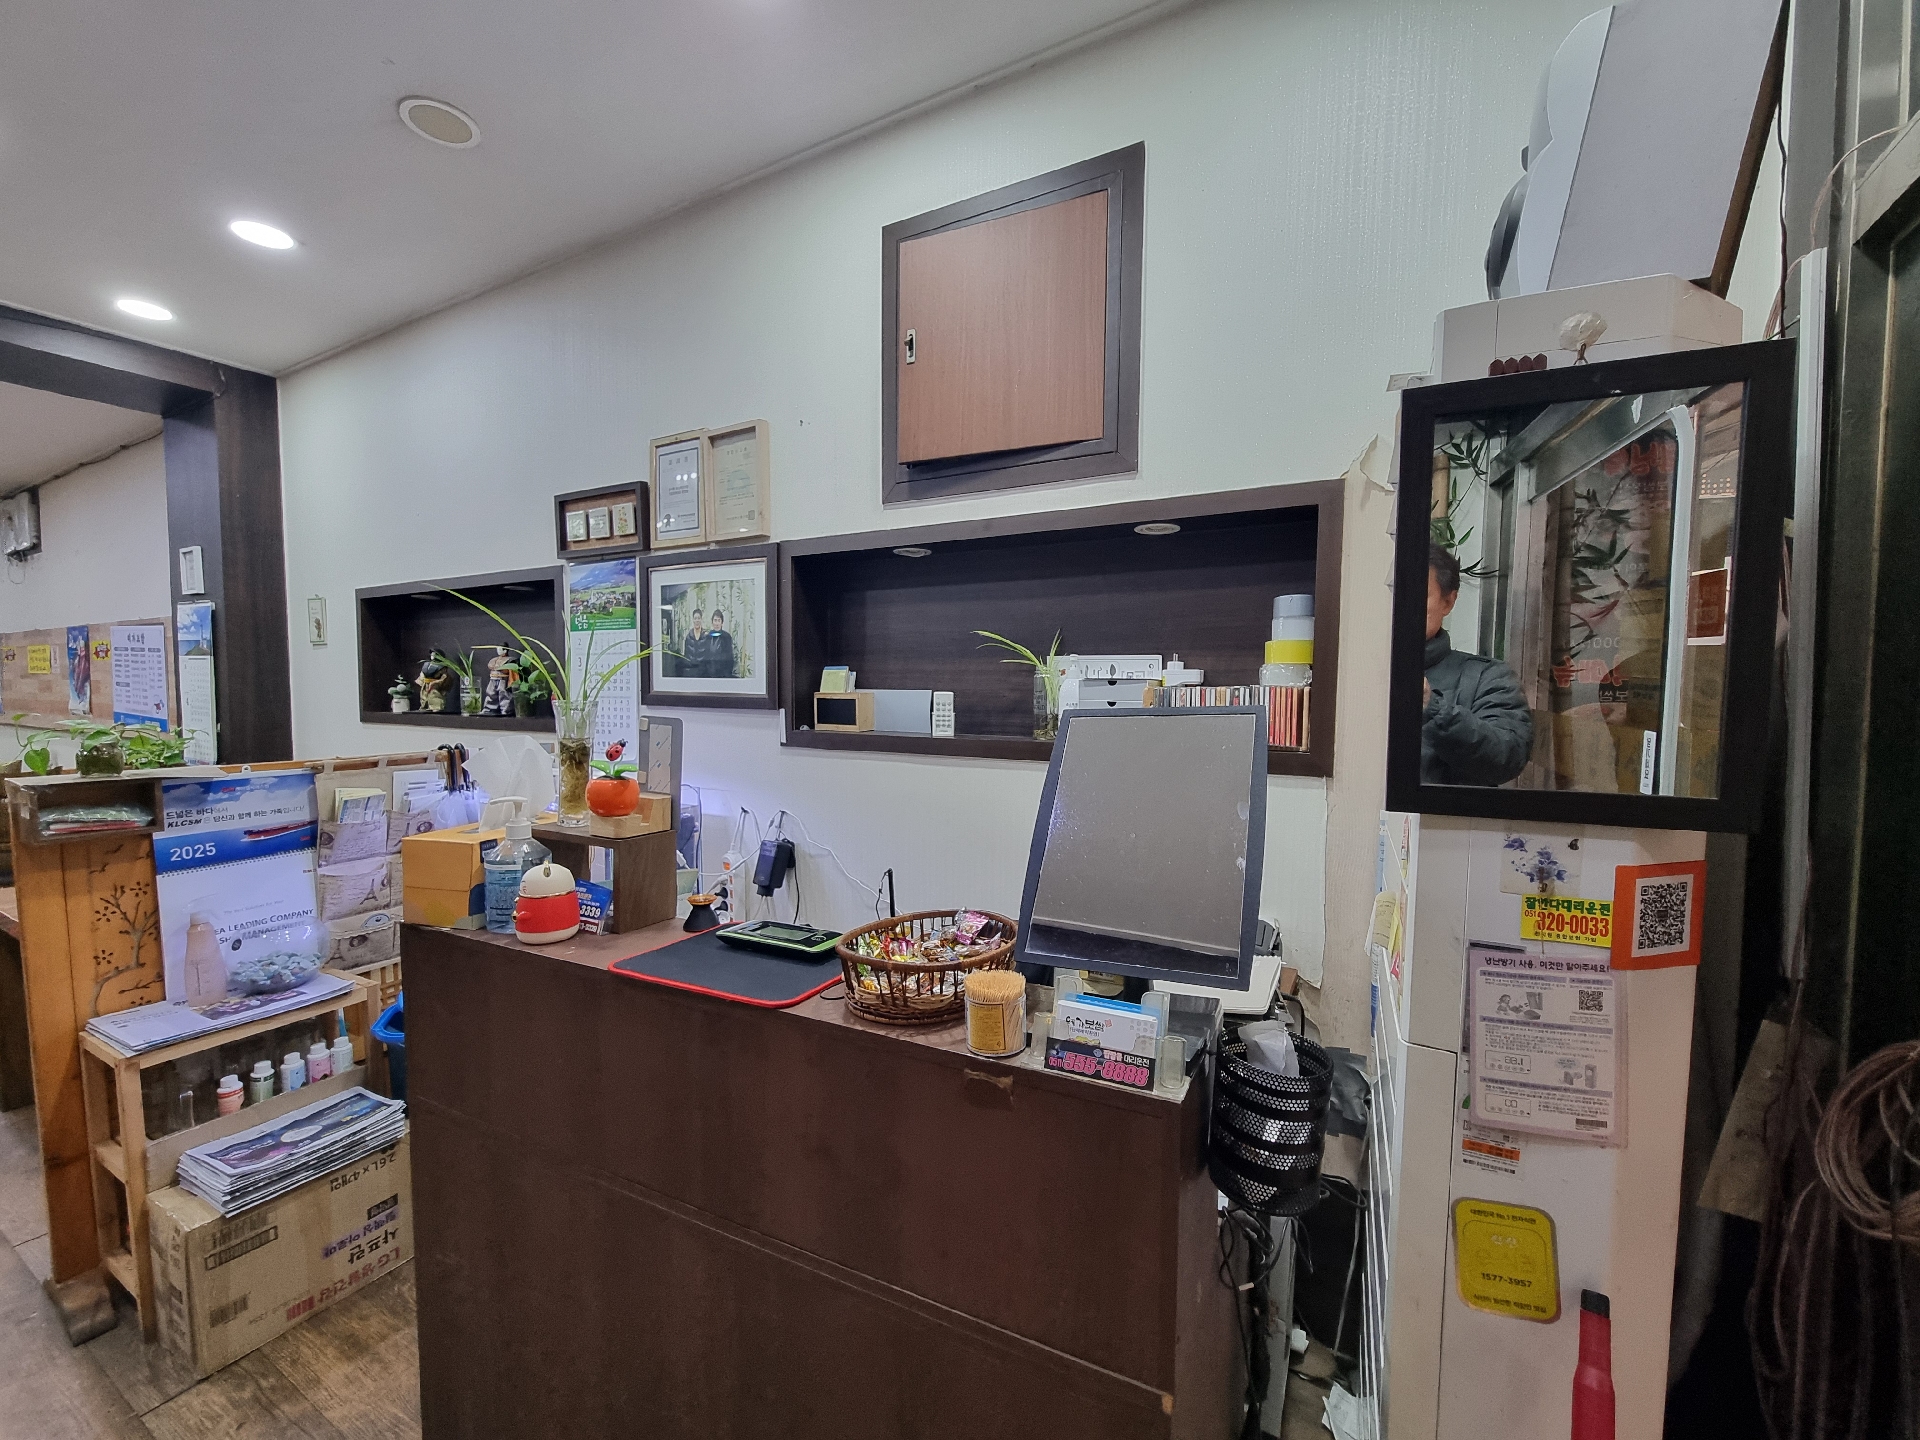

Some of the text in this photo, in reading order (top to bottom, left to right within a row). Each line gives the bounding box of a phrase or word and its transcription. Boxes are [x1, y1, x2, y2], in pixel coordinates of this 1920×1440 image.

[166, 808, 195, 820] 드넓은
[213, 814, 235, 823] 당신과
[238, 811, 252, 820] 함께
[253, 810, 268, 818] 하는
[170, 842, 217, 862] 2025
[228, 917, 268, 932] LEADING
[270, 908, 314, 923] COMPANY
[1484, 957, 1516, 968] 냉난방기
[1540, 961, 1564, 971] 이것만
[1566, 962, 1610, 973] 알아주세요!
[1063, 1052, 1150, 1087] 555-8888
[1124, 1055, 1150, 1067] 대리운전
[348, 1228, 399, 1265] 샤프란
[317, 1246, 401, 1304] LG 생활건강
[1481, 1272, 1532, 1288] 1577-3957
